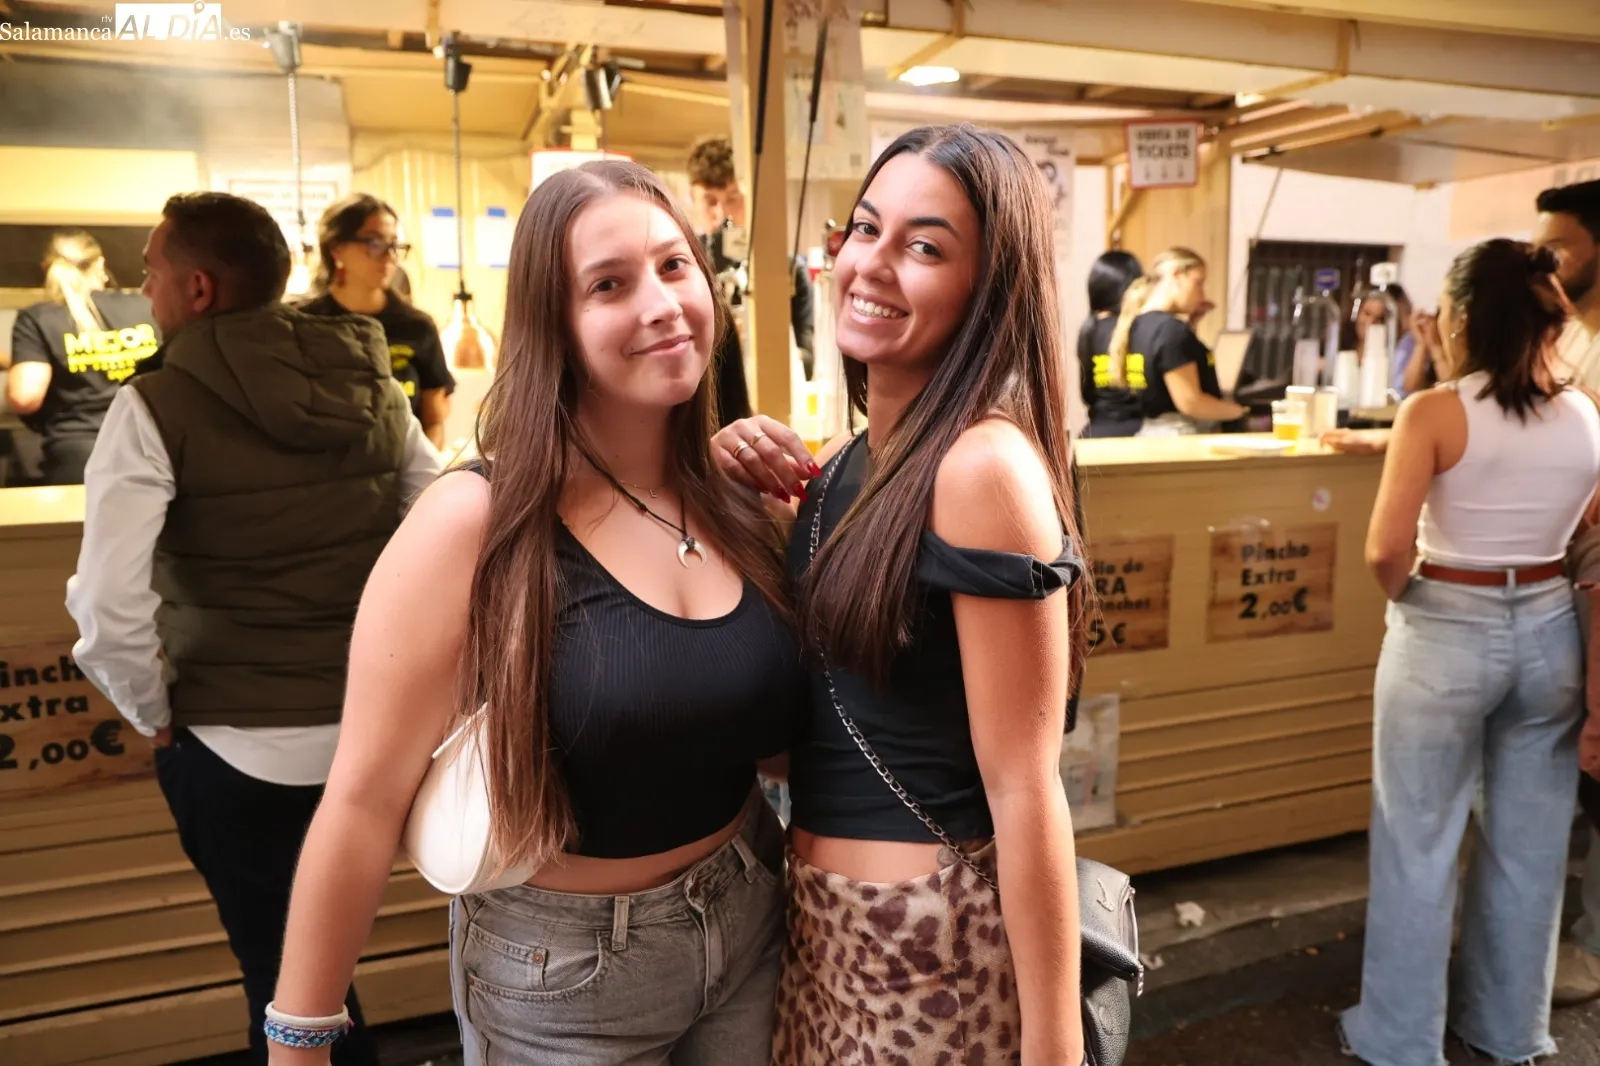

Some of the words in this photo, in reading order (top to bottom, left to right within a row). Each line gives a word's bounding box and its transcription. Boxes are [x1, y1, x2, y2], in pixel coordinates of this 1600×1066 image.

[1136, 143, 1190, 160] TICKETS
[1241, 541, 1311, 562] Pincho
[1095, 576, 1127, 597] RA
[1241, 567, 1298, 587] Extra
[1239, 587, 1309, 619] 2,00€
[0, 655, 85, 688] inch
[0, 696, 89, 721] xtra
